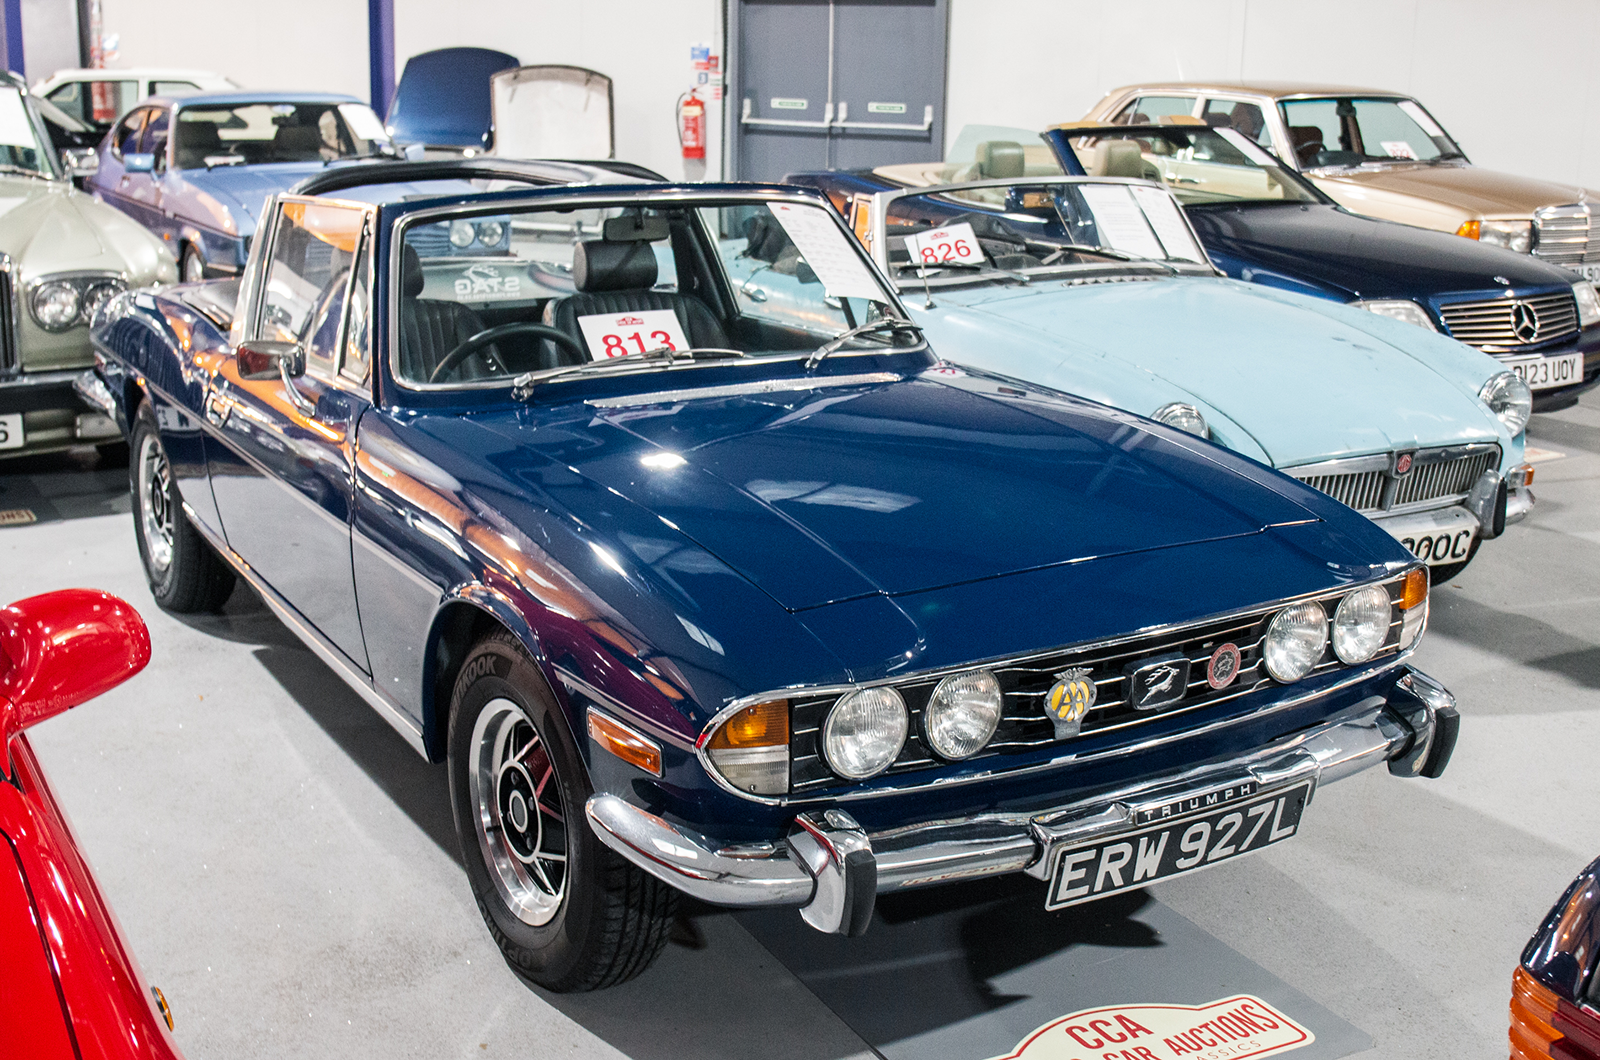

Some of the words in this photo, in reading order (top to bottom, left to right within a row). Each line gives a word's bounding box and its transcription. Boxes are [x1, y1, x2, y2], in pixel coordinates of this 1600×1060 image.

[921, 239, 971, 263] 826
[602, 330, 676, 358] 813
[1144, 784, 1251, 821] TRIUMPH
[1056, 831, 1170, 901] ERW
[1175, 797, 1296, 870] 927L
[1065, 1013, 1154, 1049] CCA
[1163, 1003, 1279, 1056] AUCTIONS
